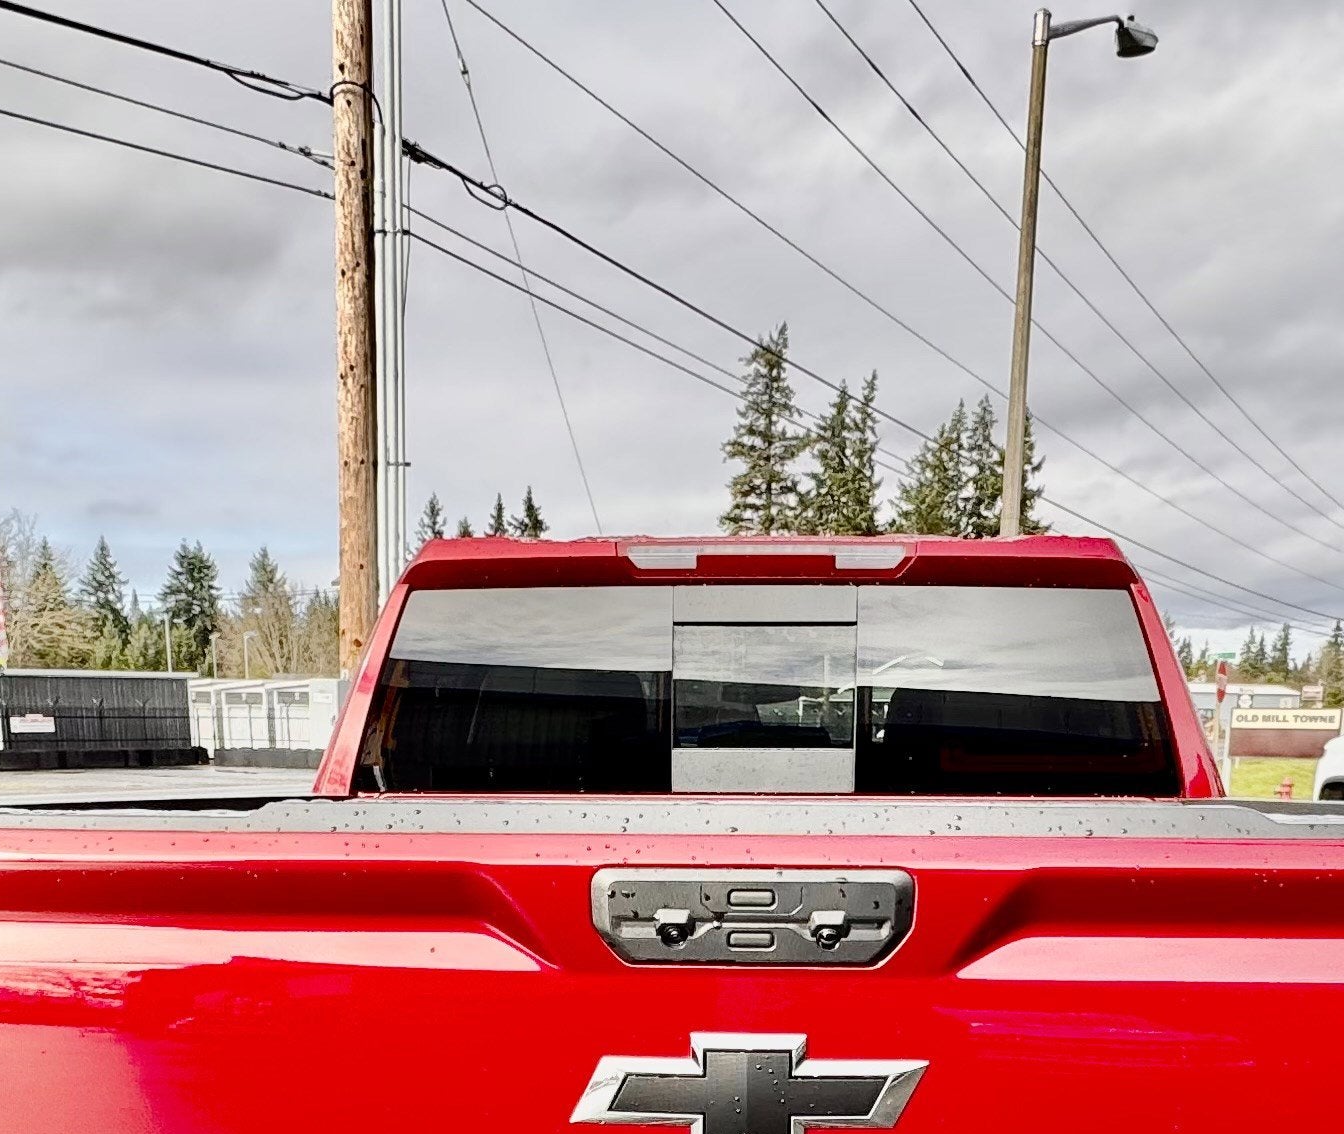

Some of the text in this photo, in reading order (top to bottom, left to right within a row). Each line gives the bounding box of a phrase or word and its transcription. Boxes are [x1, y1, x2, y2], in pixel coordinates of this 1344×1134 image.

[1236, 714, 1335, 724] OLD MILL TOWNE
